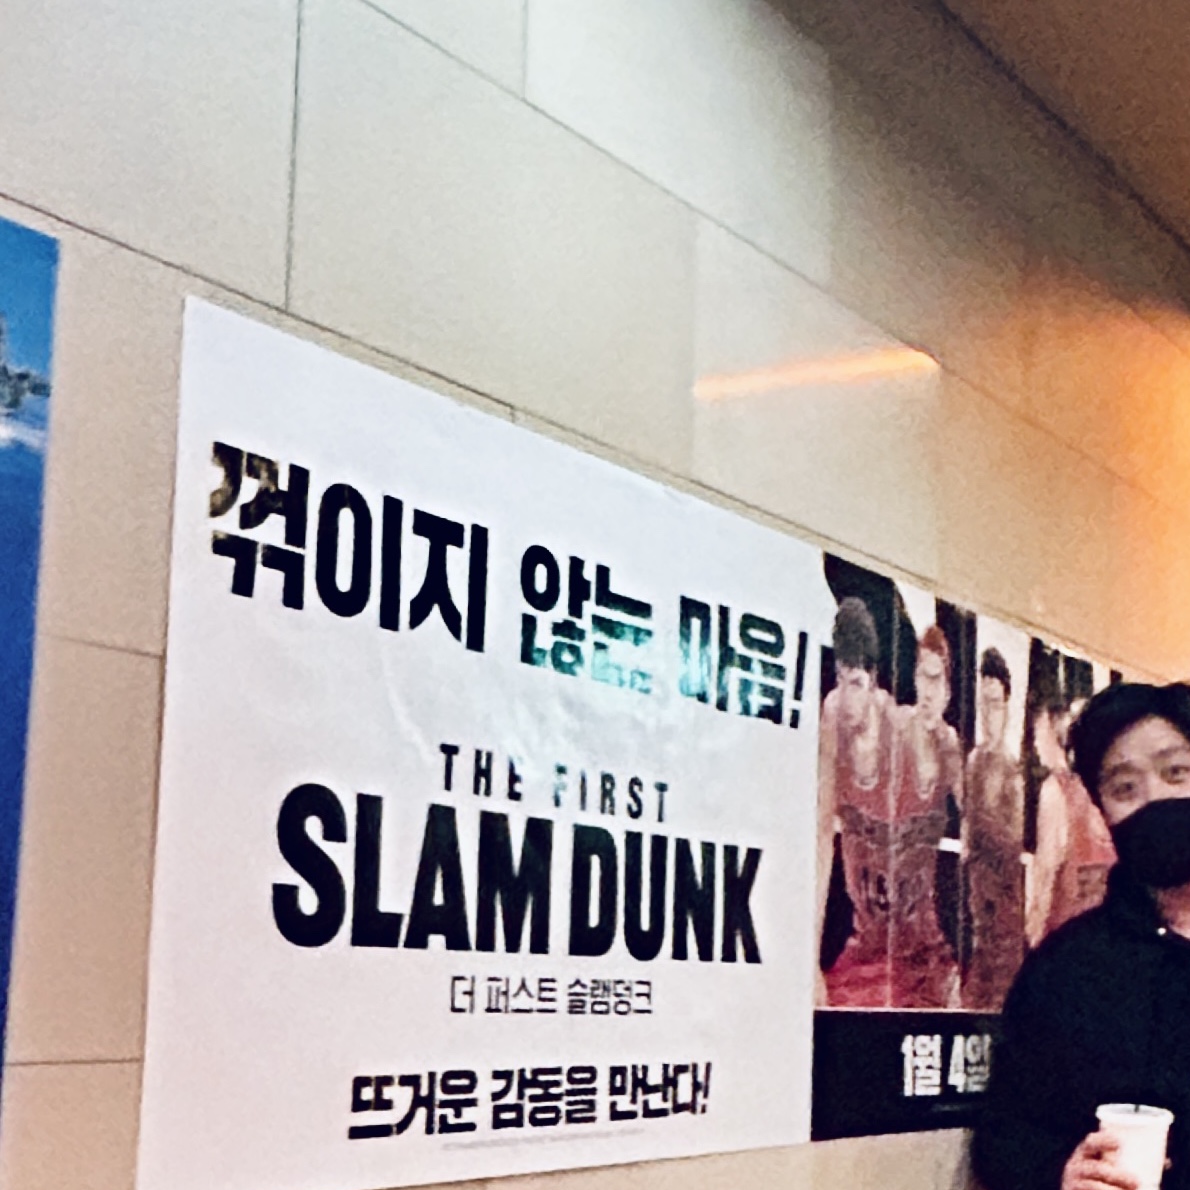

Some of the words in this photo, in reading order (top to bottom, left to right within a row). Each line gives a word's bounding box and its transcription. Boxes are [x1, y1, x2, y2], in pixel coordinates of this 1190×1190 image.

[208, 440, 489, 653] 꺾이지
[519, 543, 653, 695] 않는
[678, 594, 808, 730] 마음!
[438, 741, 523, 802] THE
[552, 762, 669, 823] FIRST
[272, 782, 554, 955] SLAM
[567, 822, 764, 964] DUNK
[449, 975, 476, 1014] 더
[484, 976, 558, 1014] 퍼스트
[566, 978, 653, 1016] 슬램덩크
[347, 1068, 479, 1140] 뜨거운
[490, 1064, 598, 1130] 감동을
[608, 1061, 712, 1121] 만난다!
[901, 1034, 942, 1097] 1월
[947, 1034, 993, 1093] 4일
